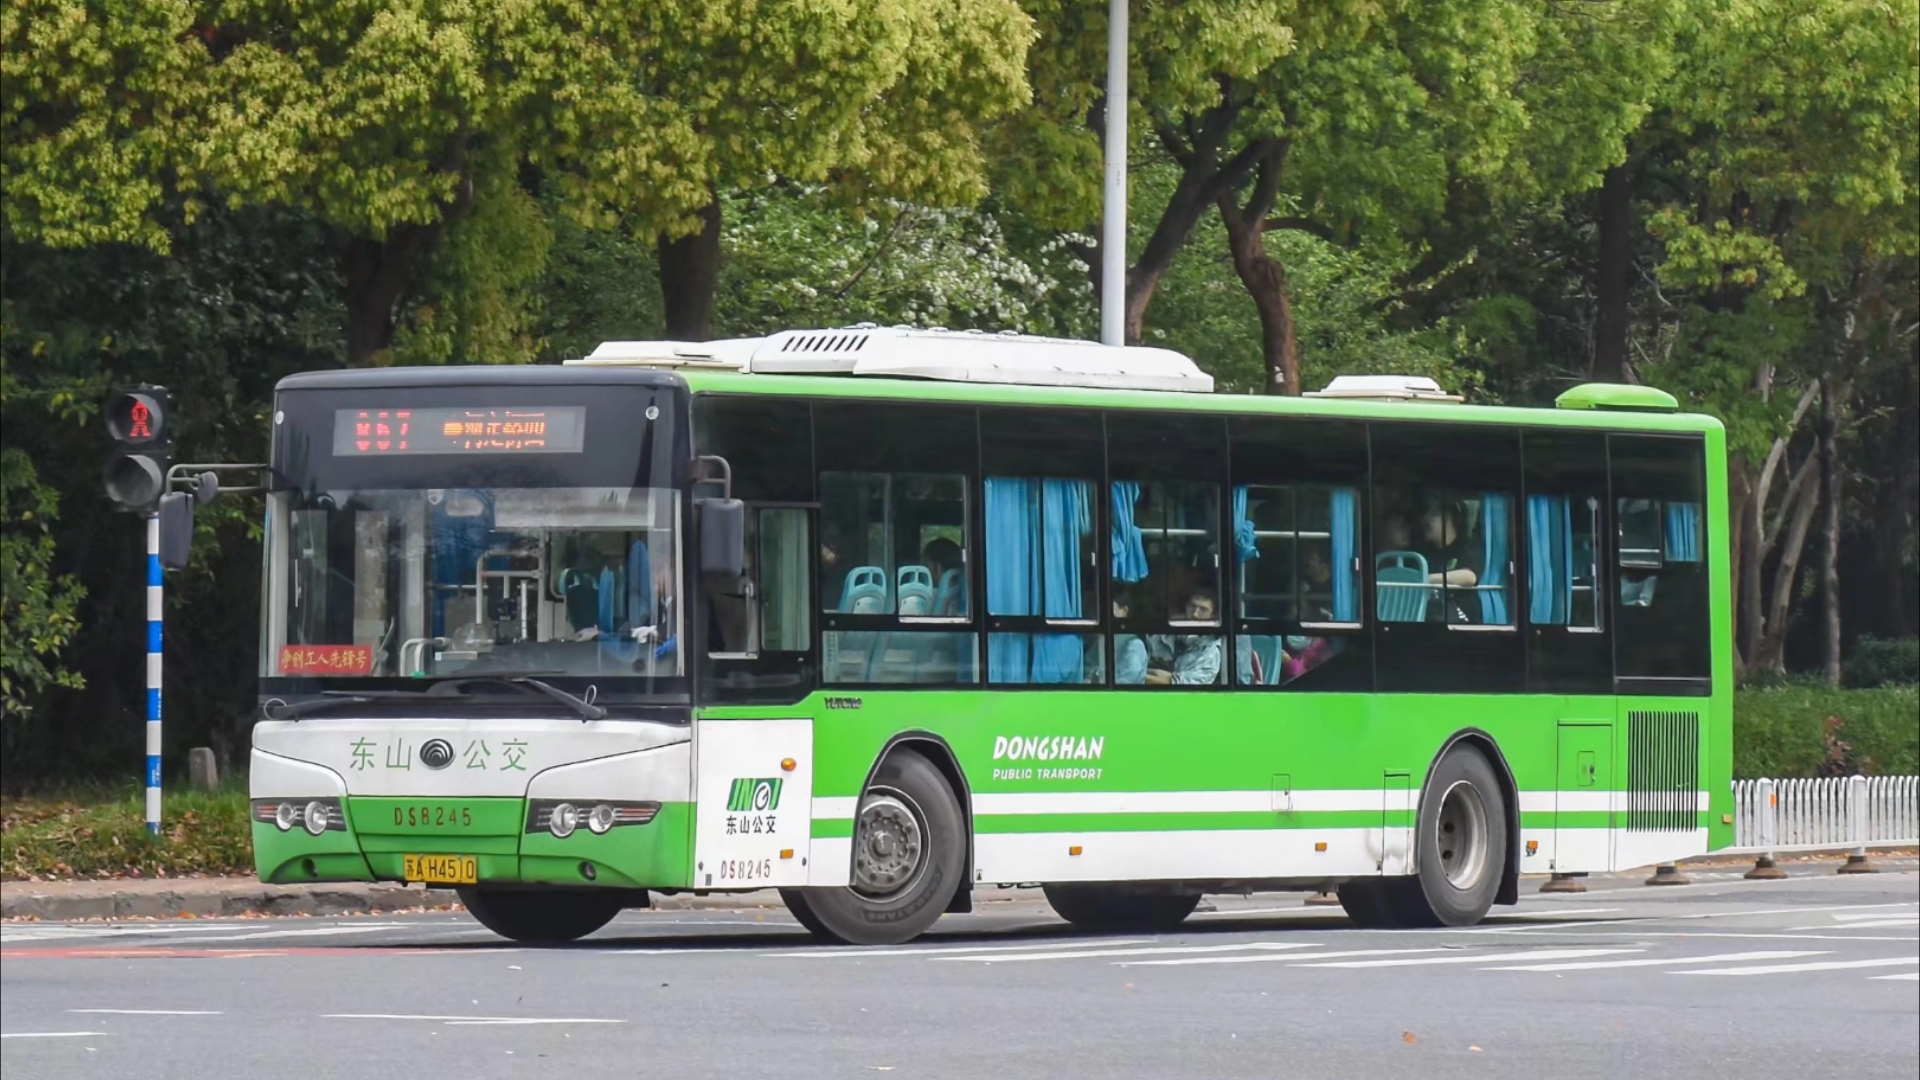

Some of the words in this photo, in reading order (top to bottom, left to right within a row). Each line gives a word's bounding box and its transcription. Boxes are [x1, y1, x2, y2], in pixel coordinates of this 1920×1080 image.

[281, 648, 367, 669] 争创工人先锋号
[992, 735, 1105, 761] DONGSHAN
[992, 767, 1032, 780] PUBLIC
[1037, 767, 1102, 780] TRANSPORT
[394, 806, 472, 827] DS8245
[726, 814, 776, 835] 东山公交
[720, 859, 771, 880] DS8245
